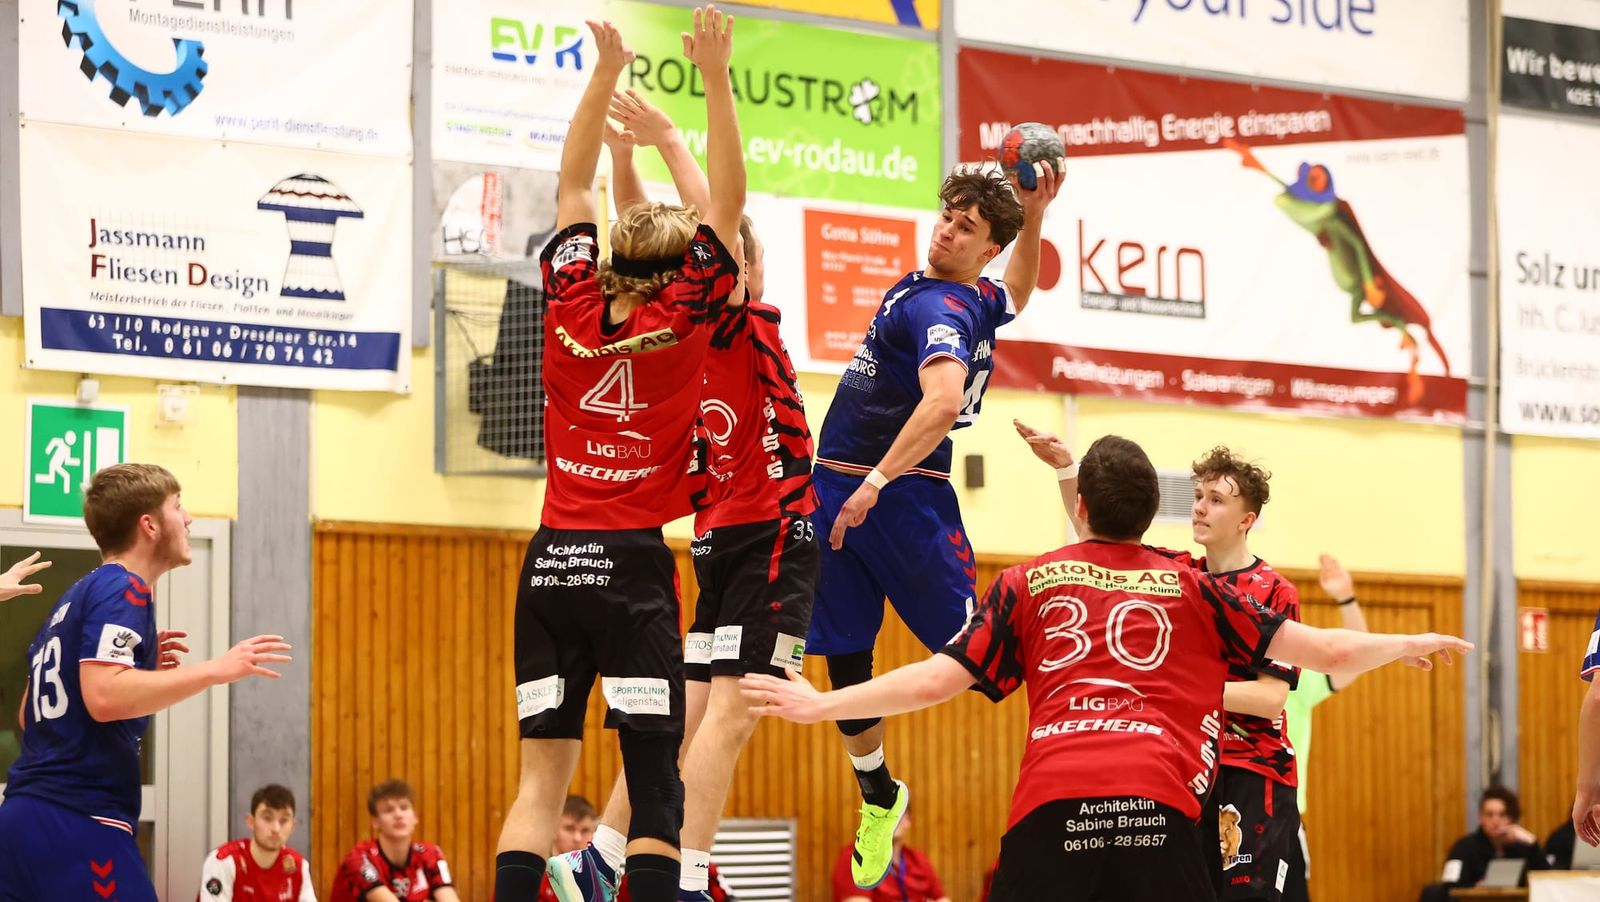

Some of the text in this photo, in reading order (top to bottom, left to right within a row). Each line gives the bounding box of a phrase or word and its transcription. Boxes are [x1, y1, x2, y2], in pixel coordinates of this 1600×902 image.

[128, 8, 295, 43] Montagedienstleistungen
[1506, 45, 1547, 77] Wir
[1057, 115, 1160, 147] nachhaltig
[1162, 112, 1234, 142] Energie
[1238, 109, 1332, 138] einsparen
[88, 217, 206, 252] Jassmann
[1078, 218, 1205, 300] kern
[1516, 250, 1566, 289] Solz
[91, 254, 270, 299] Fliesen Design
[88, 314, 106, 329] 63
[114, 316, 144, 332] 110
[151, 318, 210, 342] Rodgau
[229, 325, 303, 345] Dresdner
[112, 334, 148, 352] Tel.
[182, 340, 202, 356] 61
[212, 342, 233, 358] 06
[255, 344, 276, 360] 70
[284, 346, 305, 363] 74
[312, 349, 334, 365] 42
[579, 359, 649, 422] 4
[586, 440, 652, 460] LIGBAU
[556, 457, 663, 482] SKECHER
[793, 520, 814, 542] 35
[568, 556, 614, 569] Brauch
[1028, 563, 1179, 586] Aktobis AG
[1149, 586, 1181, 595] Klima
[1037, 595, 1173, 672] 30
[32, 636, 69, 723] 13
[612, 685, 667, 696] SPORTKLINIK
[1069, 697, 1144, 712] LIGBAU
[1031, 718, 1163, 742] SKECHERS
[1079, 798, 1156, 815] Architektin
[1065, 813, 1166, 833] Sabine Brauch
